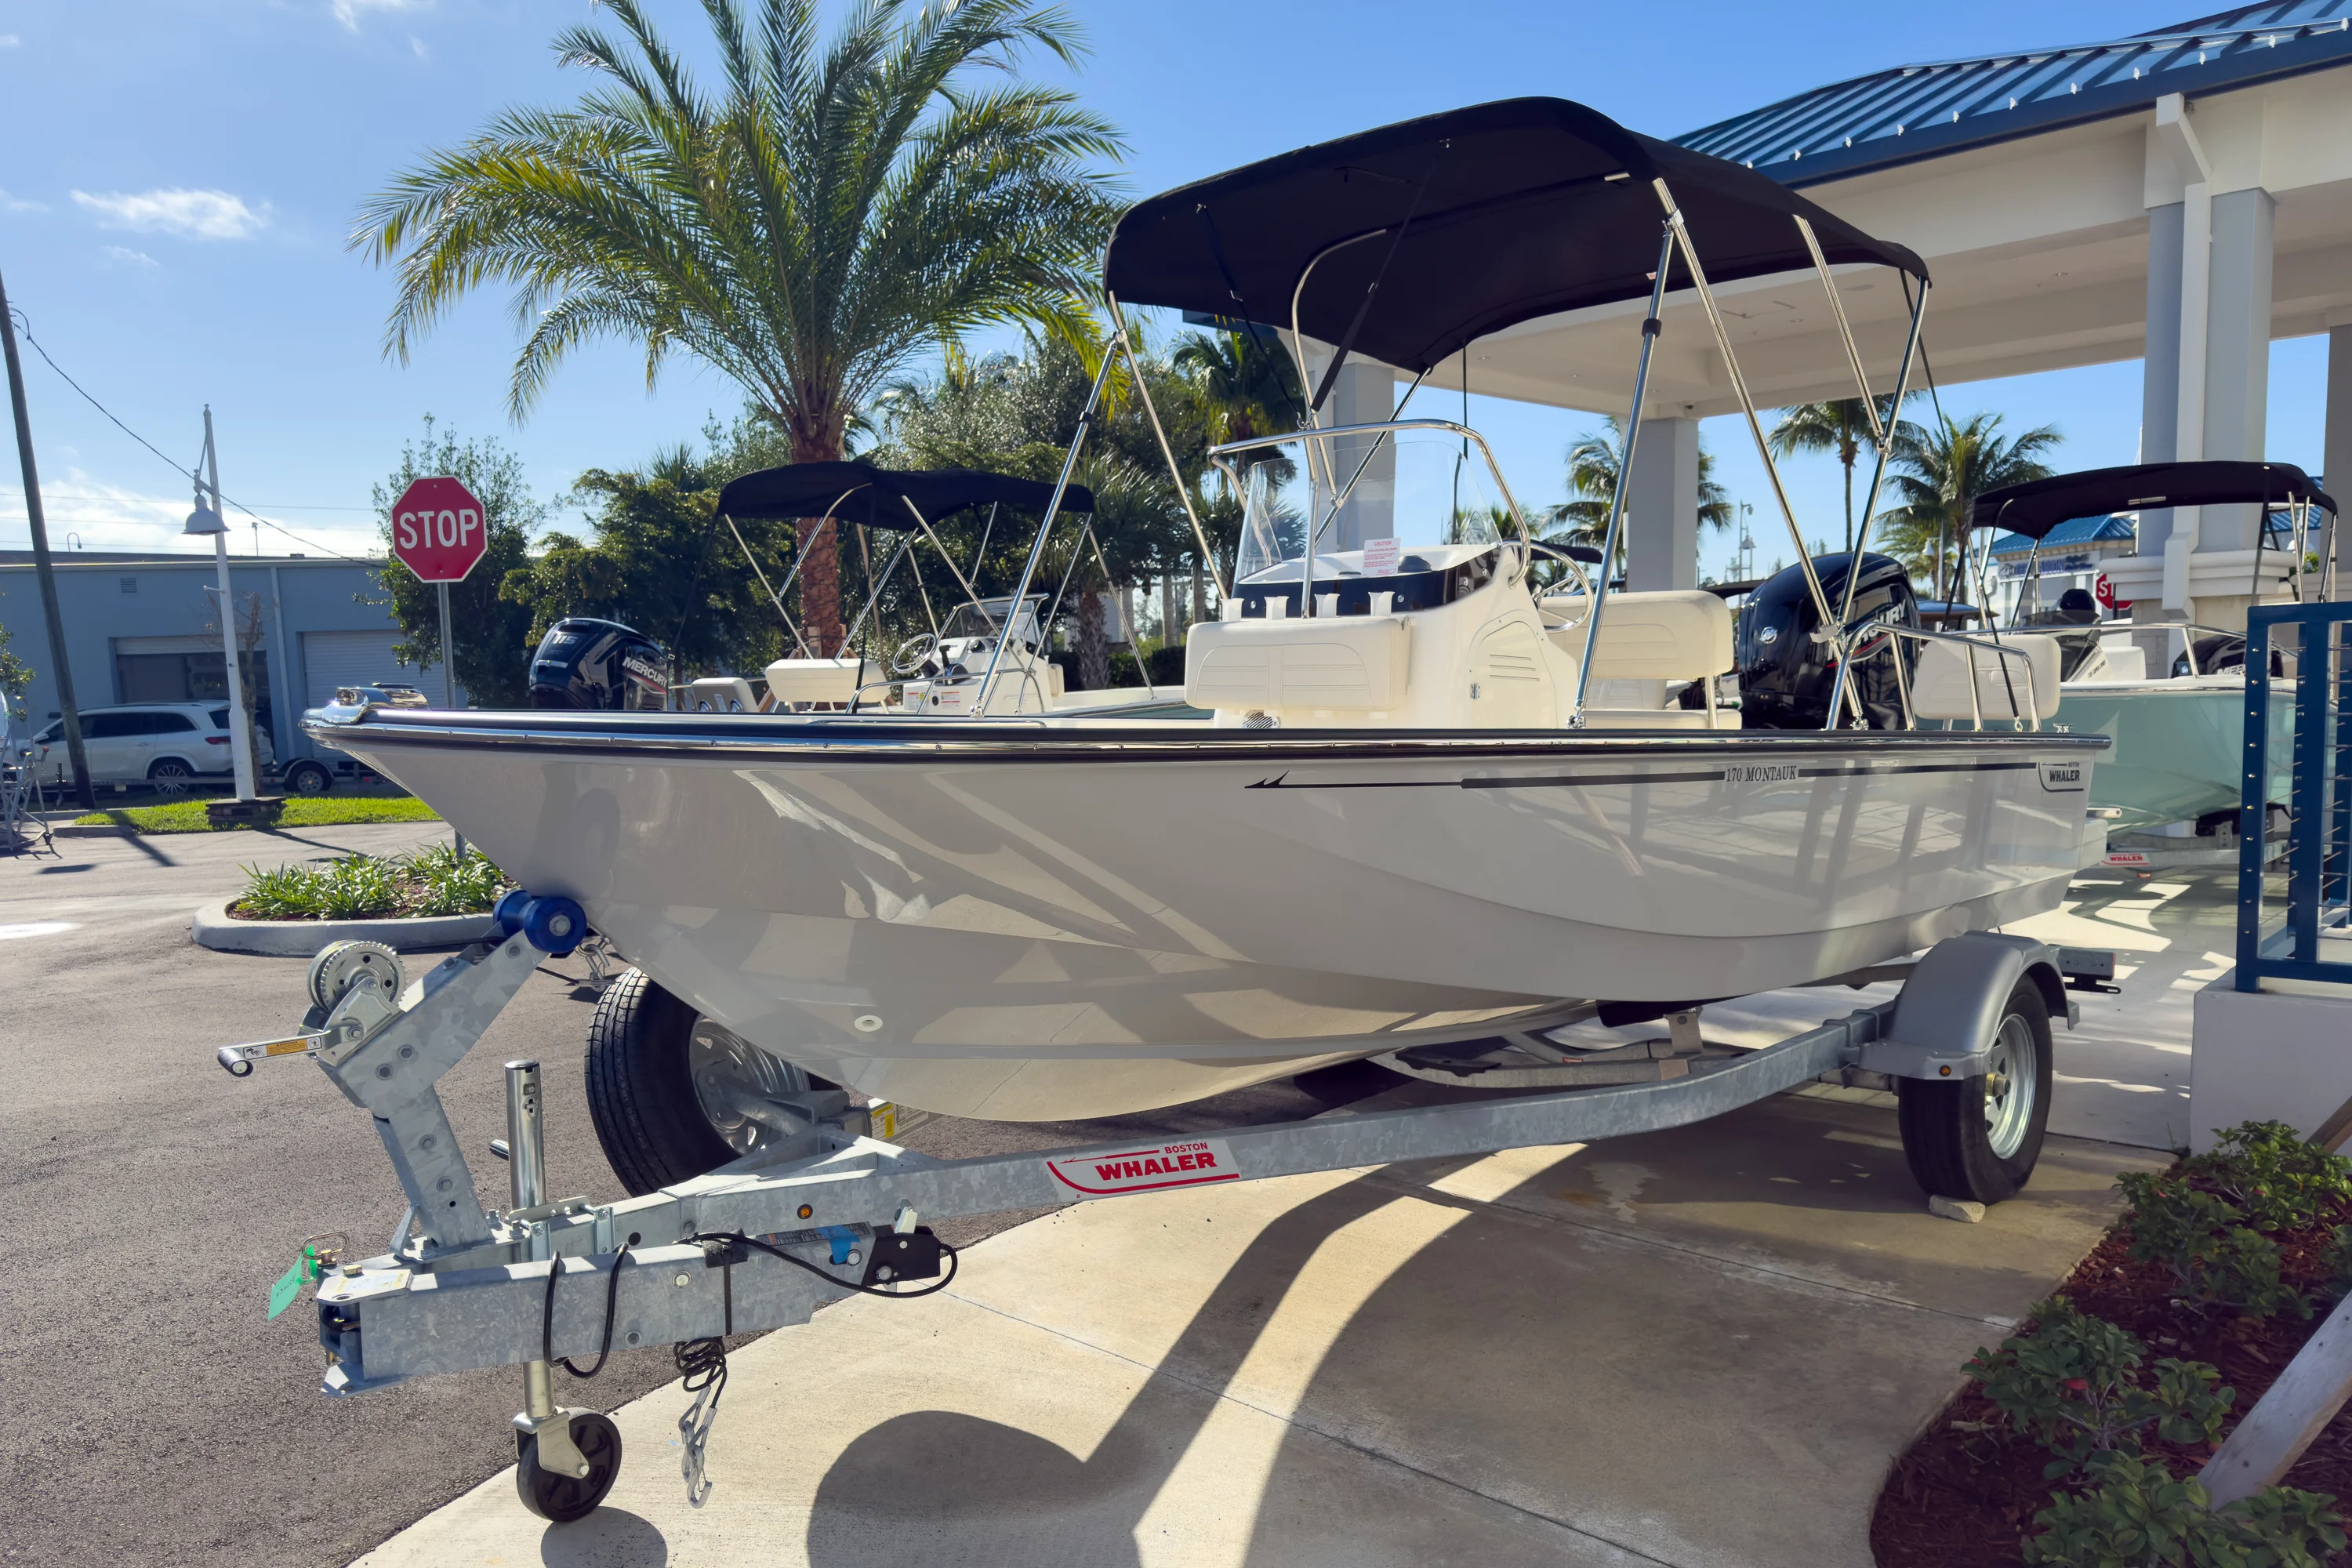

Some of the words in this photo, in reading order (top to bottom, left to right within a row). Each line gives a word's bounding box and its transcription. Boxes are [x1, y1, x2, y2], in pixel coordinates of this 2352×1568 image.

[399, 508, 478, 550] STOP
[552, 635, 579, 645] 115
[622, 657, 667, 688] MERCURY
[1726, 768, 1742, 782] 170
[1745, 765, 1797, 782] MONTAUK
[2049, 770, 2080, 782] WHALER
[1164, 1142, 1208, 1155] BOSTON
[1094, 1152, 1218, 1181] WHALER
